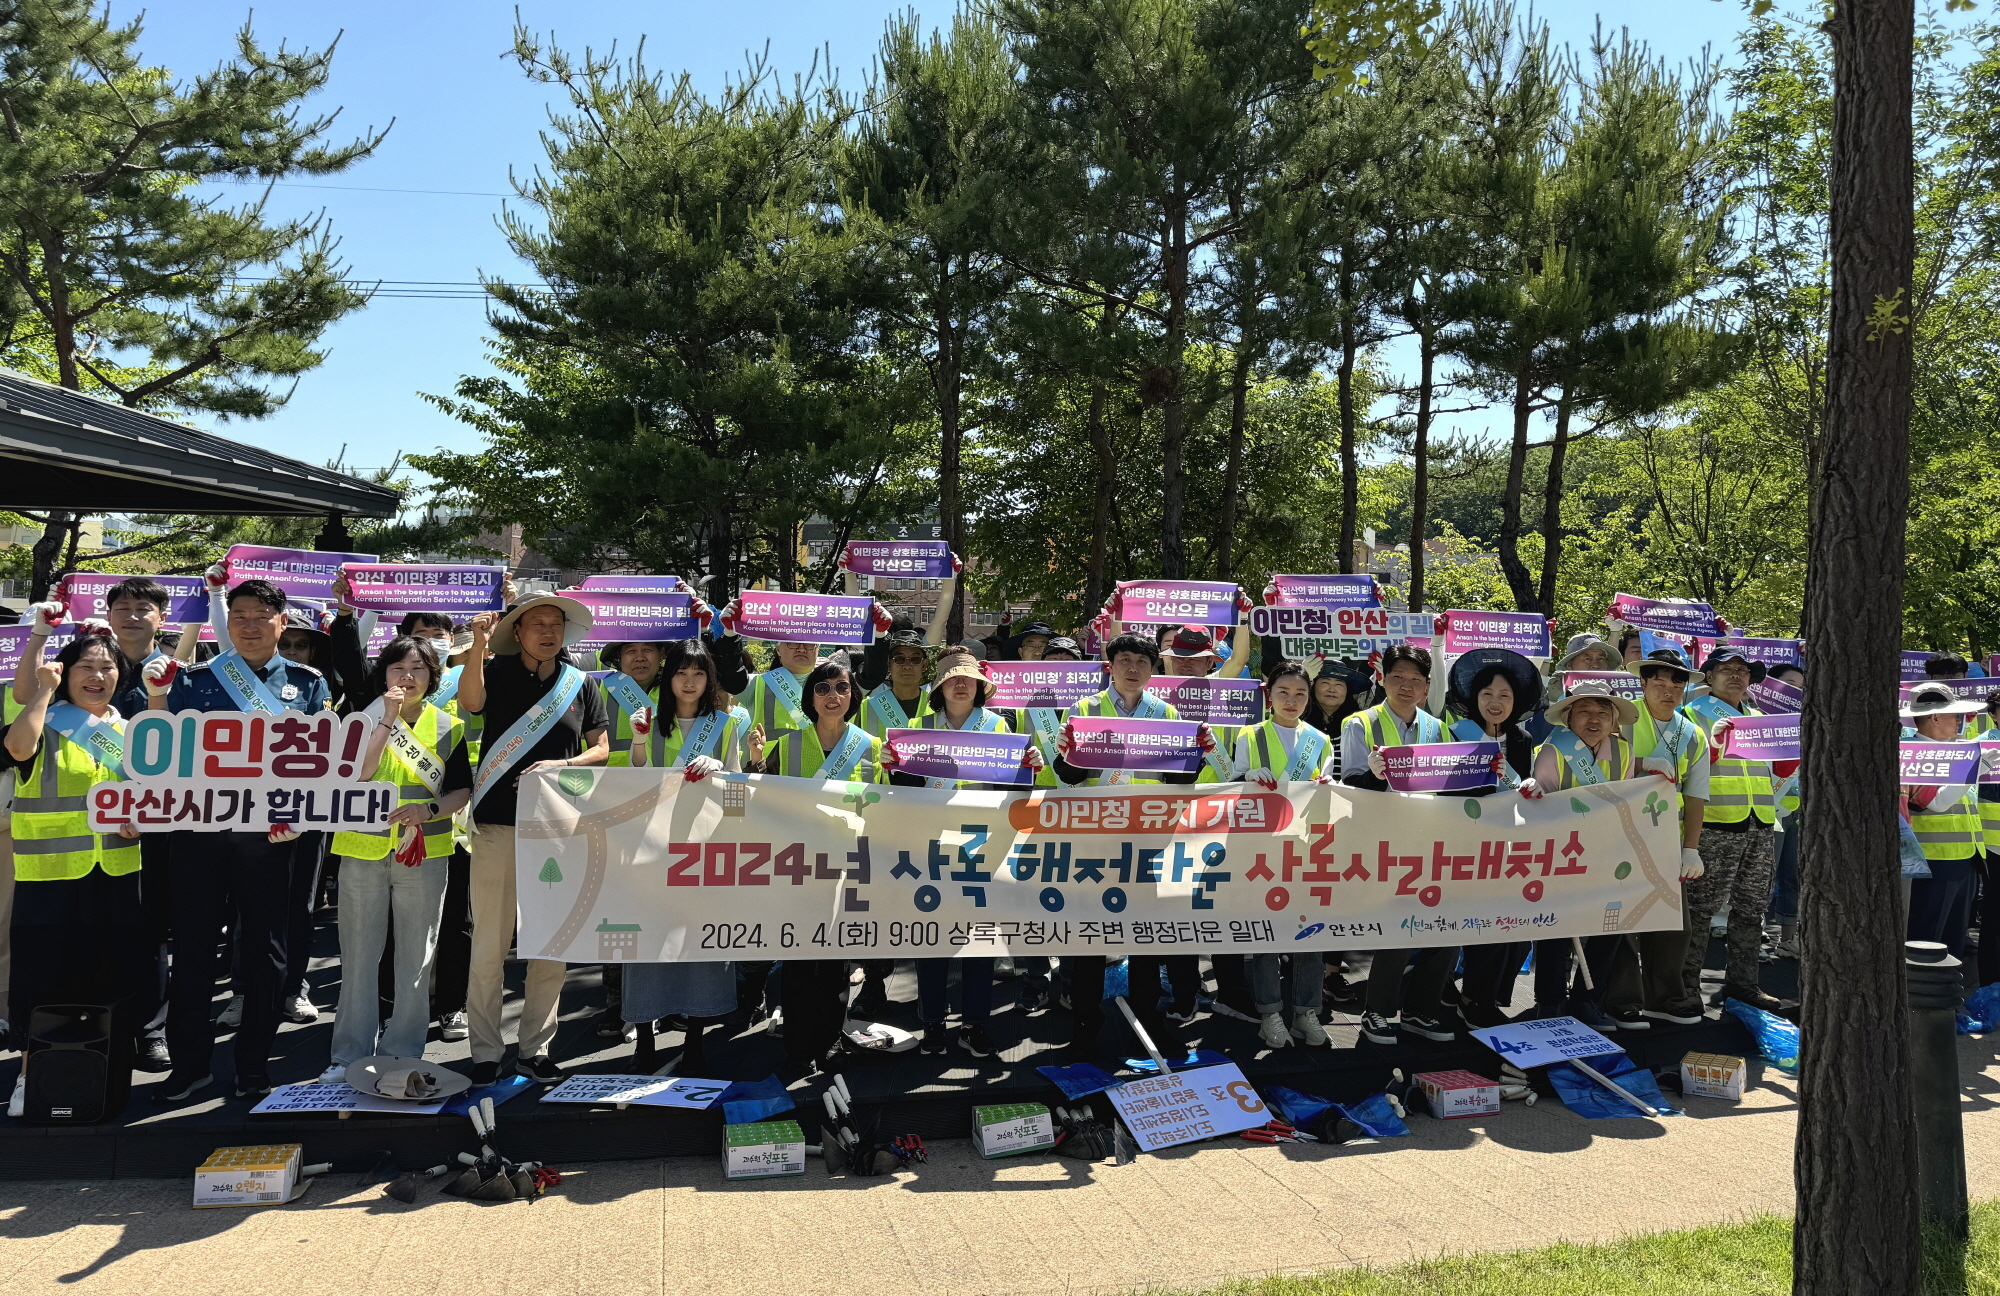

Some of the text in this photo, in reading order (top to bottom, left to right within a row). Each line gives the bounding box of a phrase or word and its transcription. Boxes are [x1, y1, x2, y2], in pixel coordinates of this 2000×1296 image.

[853, 547, 946, 558] 이민청은 상호문화도시
[232, 558, 287, 573] 안산의 길!
[872, 558, 927, 572] 안산으로
[234, 572, 253, 580] Path
[264, 574, 292, 582] Ansan!
[292, 576, 328, 586] Gateway
[354, 571, 492, 586] 안산 최적지
[358, 588, 384, 596] Ansan
[394, 588, 407, 596] the
[408, 588, 426, 596] best
[427, 588, 450, 598] place
[1125, 587, 1233, 602] 이민청은 상호문화도시
[1282, 586, 1361, 596] 안산의 대한민국의
[354, 595, 493, 605] Korean Immigration Service Agency
[598, 605, 691, 618] 길! 대한민국의 길!
[744, 602, 865, 619] 안산 최적지
[1145, 602, 1209, 618] 안산으로
[1621, 603, 1715, 622] 안산 최적지
[619, 620, 653, 629] Gateway
[807, 620, 827, 628] place
[1253, 608, 1434, 636] 이민청! 안산의 길!
[1453, 619, 1543, 635] 안산 최적지
[742, 624, 768, 632] Korean
[769, 626, 811, 635] Immigration
[839, 629, 865, 637] Agency
[1285, 637, 1377, 658] 대한민국의
[1763, 646, 1794, 658] 최적지
[991, 671, 1103, 685] 안산 최적지
[1014, 694, 1053, 702] Immigration
[1147, 686, 1255, 702] 안산 최적지
[1232, 711, 1256, 719] Agency
[1073, 731, 1183, 748] 안산의 길! 대한민국의
[1734, 727, 1774, 740] 안산의 길!
[88, 731, 124, 759] 깨끗하고
[130, 716, 363, 779] 이민청!
[504, 735, 524, 753] 우리
[895, 742, 1009, 759] 안산의 길! 대한민국의
[1075, 745, 1093, 754] Path
[1103, 747, 1129, 755] Ansan!
[1129, 748, 1163, 757] Gateway
[1173, 749, 1198, 757] Korea!
[925, 756, 952, 764] Ansan!
[953, 759, 987, 768] Gateway
[997, 761, 1022, 769] Korea!
[1387, 754, 1494, 769] 안산의 길! 대한민국의 길!
[1915, 749, 1976, 761] 상호문화도시
[1434, 768, 1461, 777] Gateway
[94, 787, 390, 825] 안산시가 합니다!
[1038, 796, 1267, 830] 이민청 유치 기원
[666, 836, 871, 912] 2024년
[889, 824, 993, 912] 상록
[1007, 838, 1231, 913] 행정타운
[1328, 922, 1383, 938] 안산시
[1400, 912, 1559, 938] 시민과 자유로운 혁신도시 안산
[700, 917, 1275, 949] 2024. 6. 9:00 상록구청사 주변 행정타운 일대
[1519, 1017, 1575, 1031] 가로정비과
[1545, 1034, 1603, 1048] 평생학습관
[1115, 1074, 1184, 1099] 상록경찰서
[1119, 1087, 1199, 1116] 농업기술센터
[1468, 1094, 1489, 1107] 복숭아
[1129, 1103, 1209, 1132] 도시정보센터
[1013, 1124, 1040, 1139] 청포도
[1144, 1119, 1215, 1147] 도시주택과
[743, 1151, 790, 1165] 과수원 청포도
[211, 1179, 267, 1194] 과수원 오렌지
